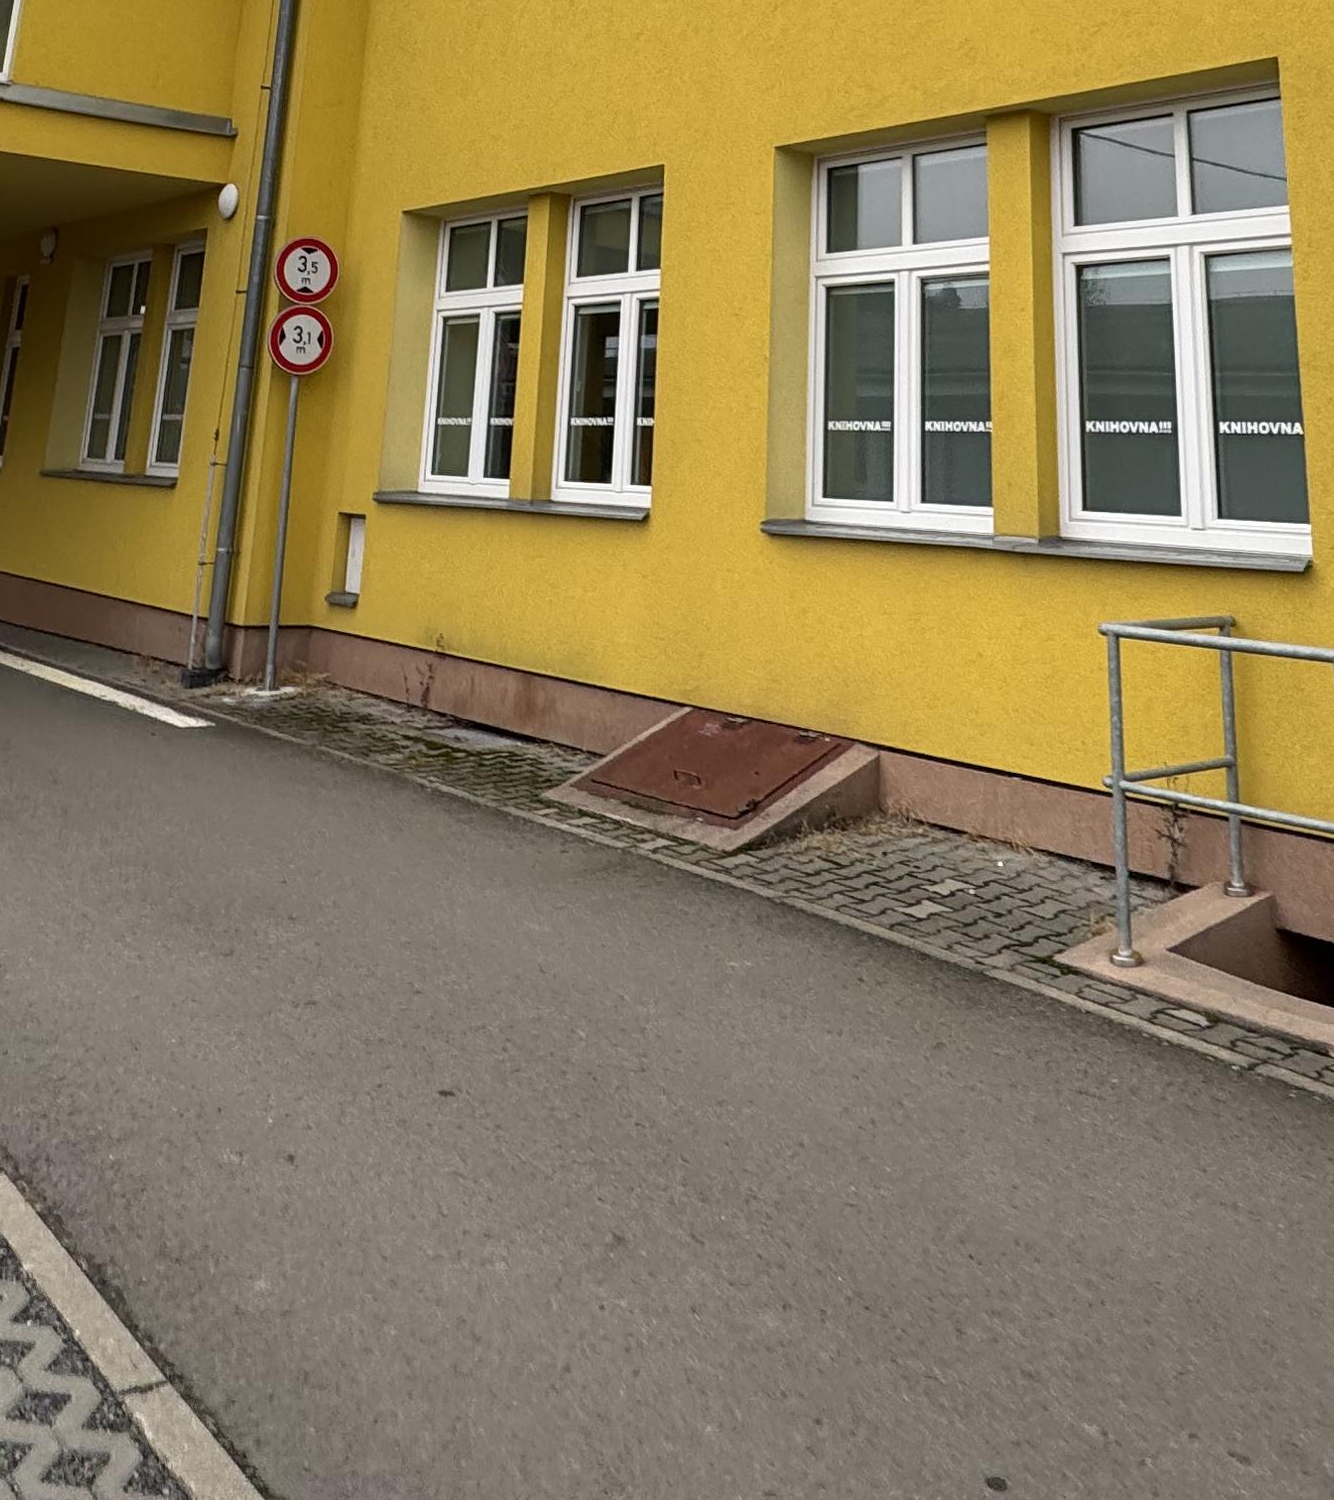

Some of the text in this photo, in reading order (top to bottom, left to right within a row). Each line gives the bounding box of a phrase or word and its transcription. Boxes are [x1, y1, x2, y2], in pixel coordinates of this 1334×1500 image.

[297, 255, 319, 275] 3,5
[300, 277, 312, 285] m
[292, 325, 312, 346] 3,1
[1085, 420, 1172, 434] KNIHOVNA!!!
[1218, 421, 1304, 435] KNIHOVNA
